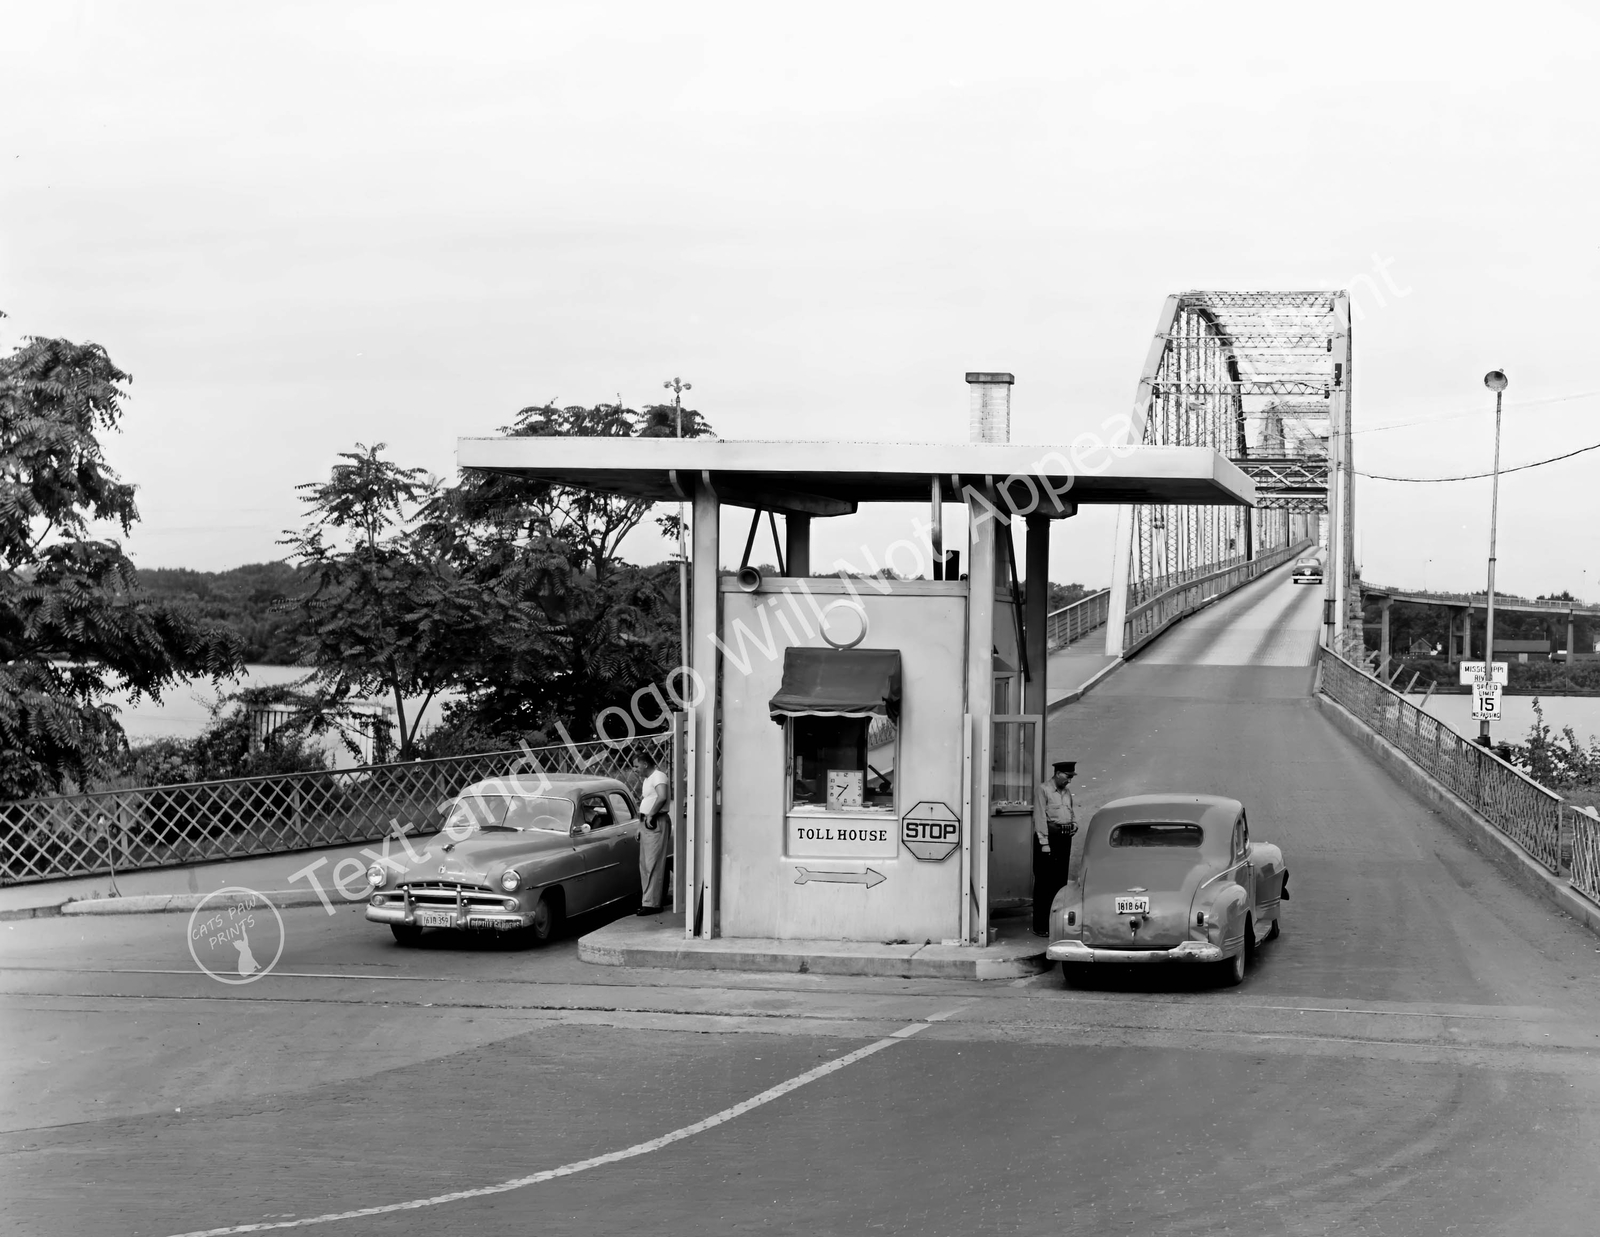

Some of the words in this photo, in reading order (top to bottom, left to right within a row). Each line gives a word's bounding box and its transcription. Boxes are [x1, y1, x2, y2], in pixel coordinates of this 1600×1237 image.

[1479, 697, 1495, 712] 15
[797, 827, 834, 841] TOLL
[837, 828, 888, 842] HOUSE
[905, 822, 957, 840] STOP
